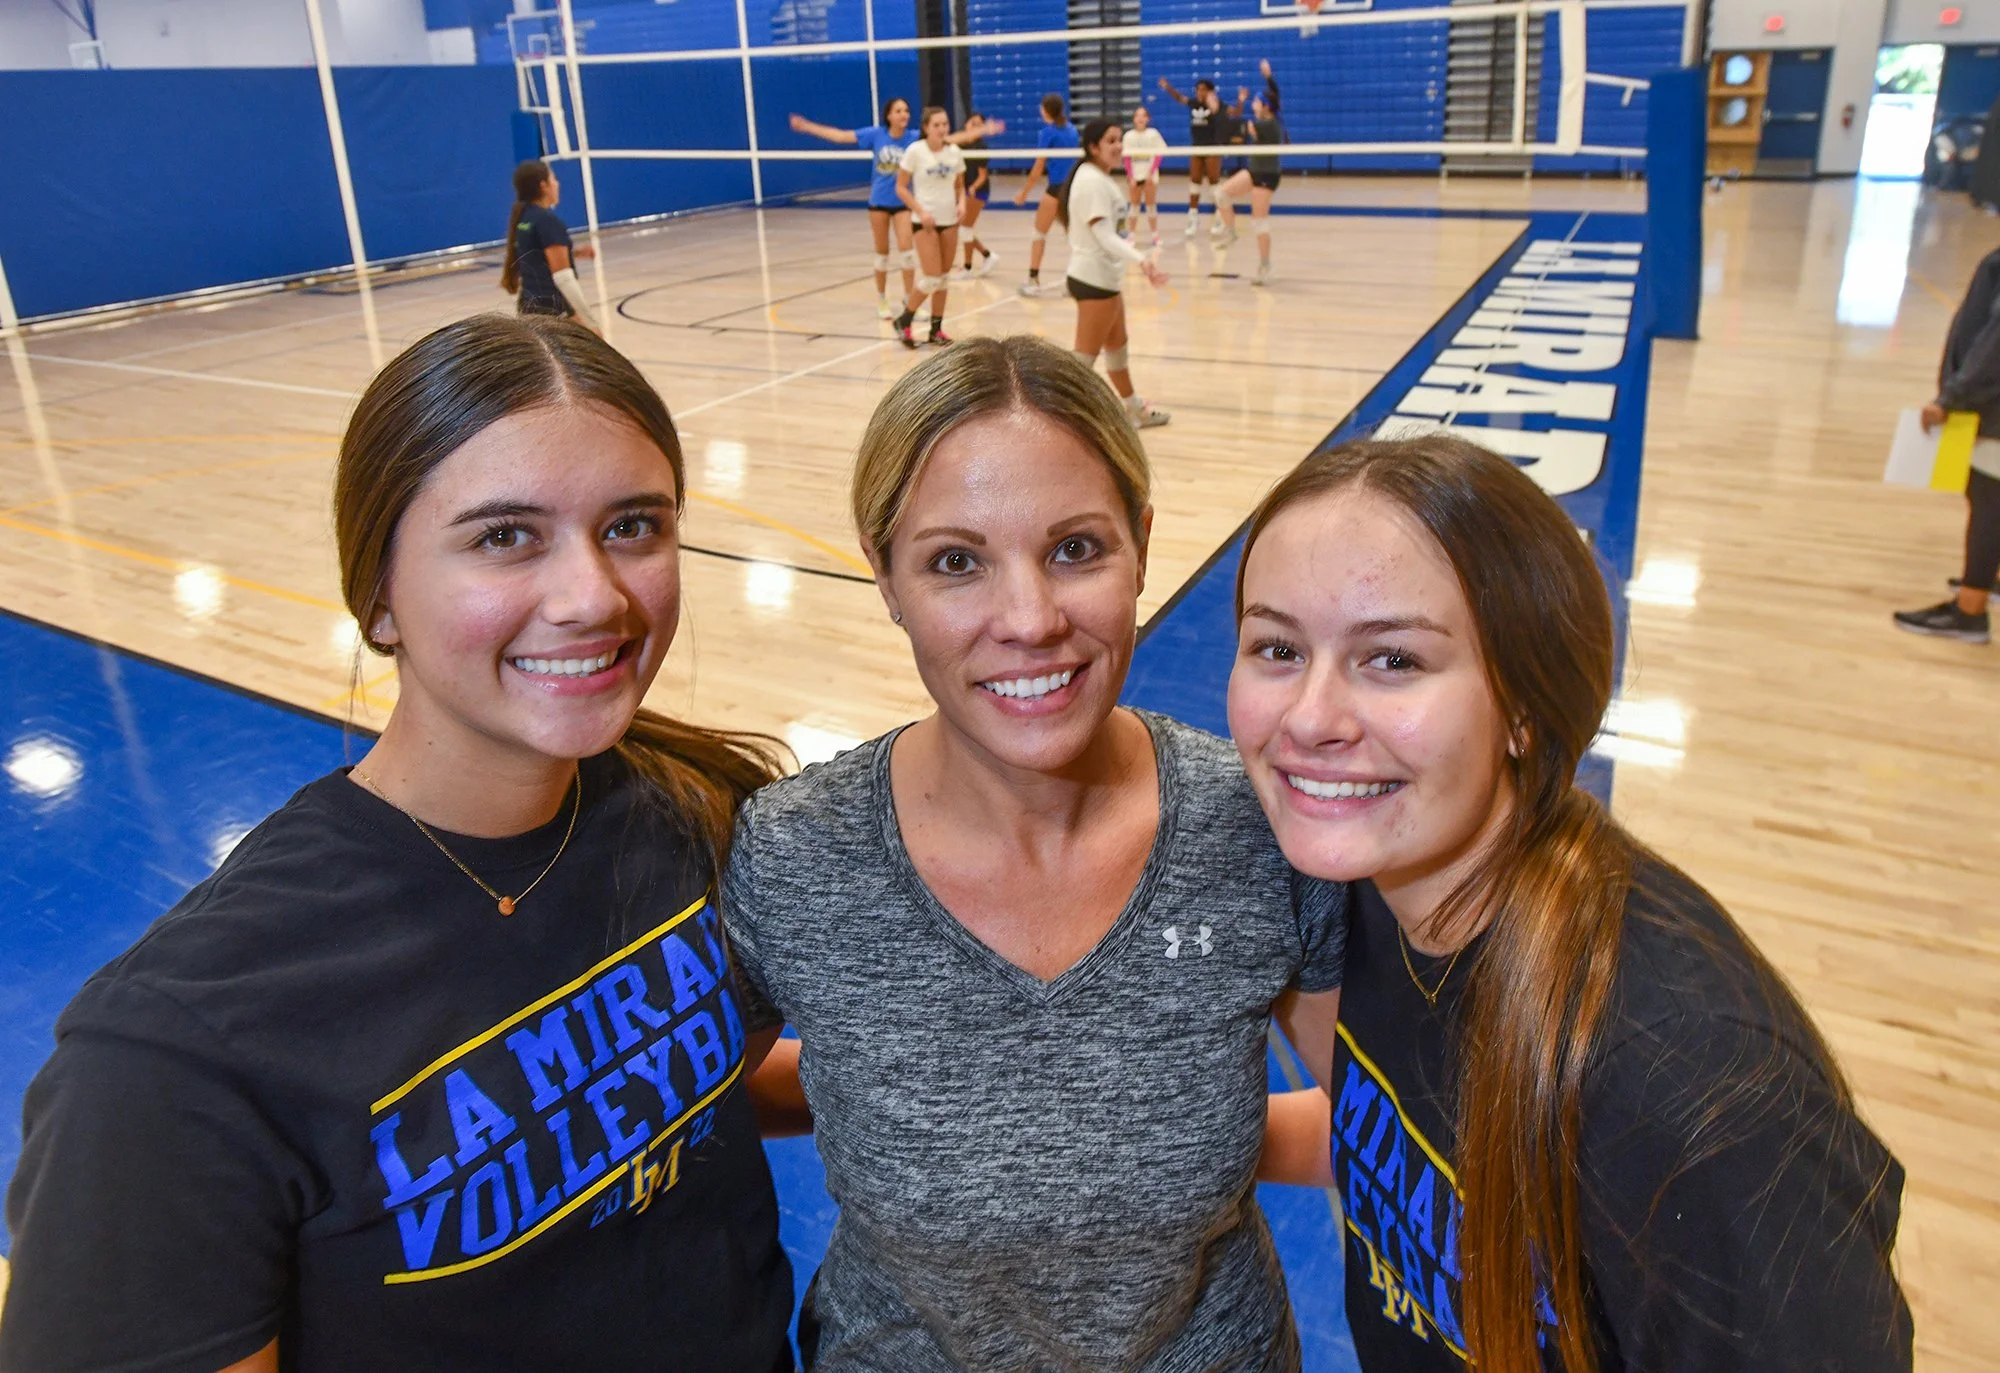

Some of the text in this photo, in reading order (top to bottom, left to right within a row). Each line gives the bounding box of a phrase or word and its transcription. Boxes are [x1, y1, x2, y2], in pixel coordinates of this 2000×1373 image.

[369, 1068, 518, 1210] LA
[589, 1185, 623, 1229] 20
[689, 1106, 715, 1148] 22
